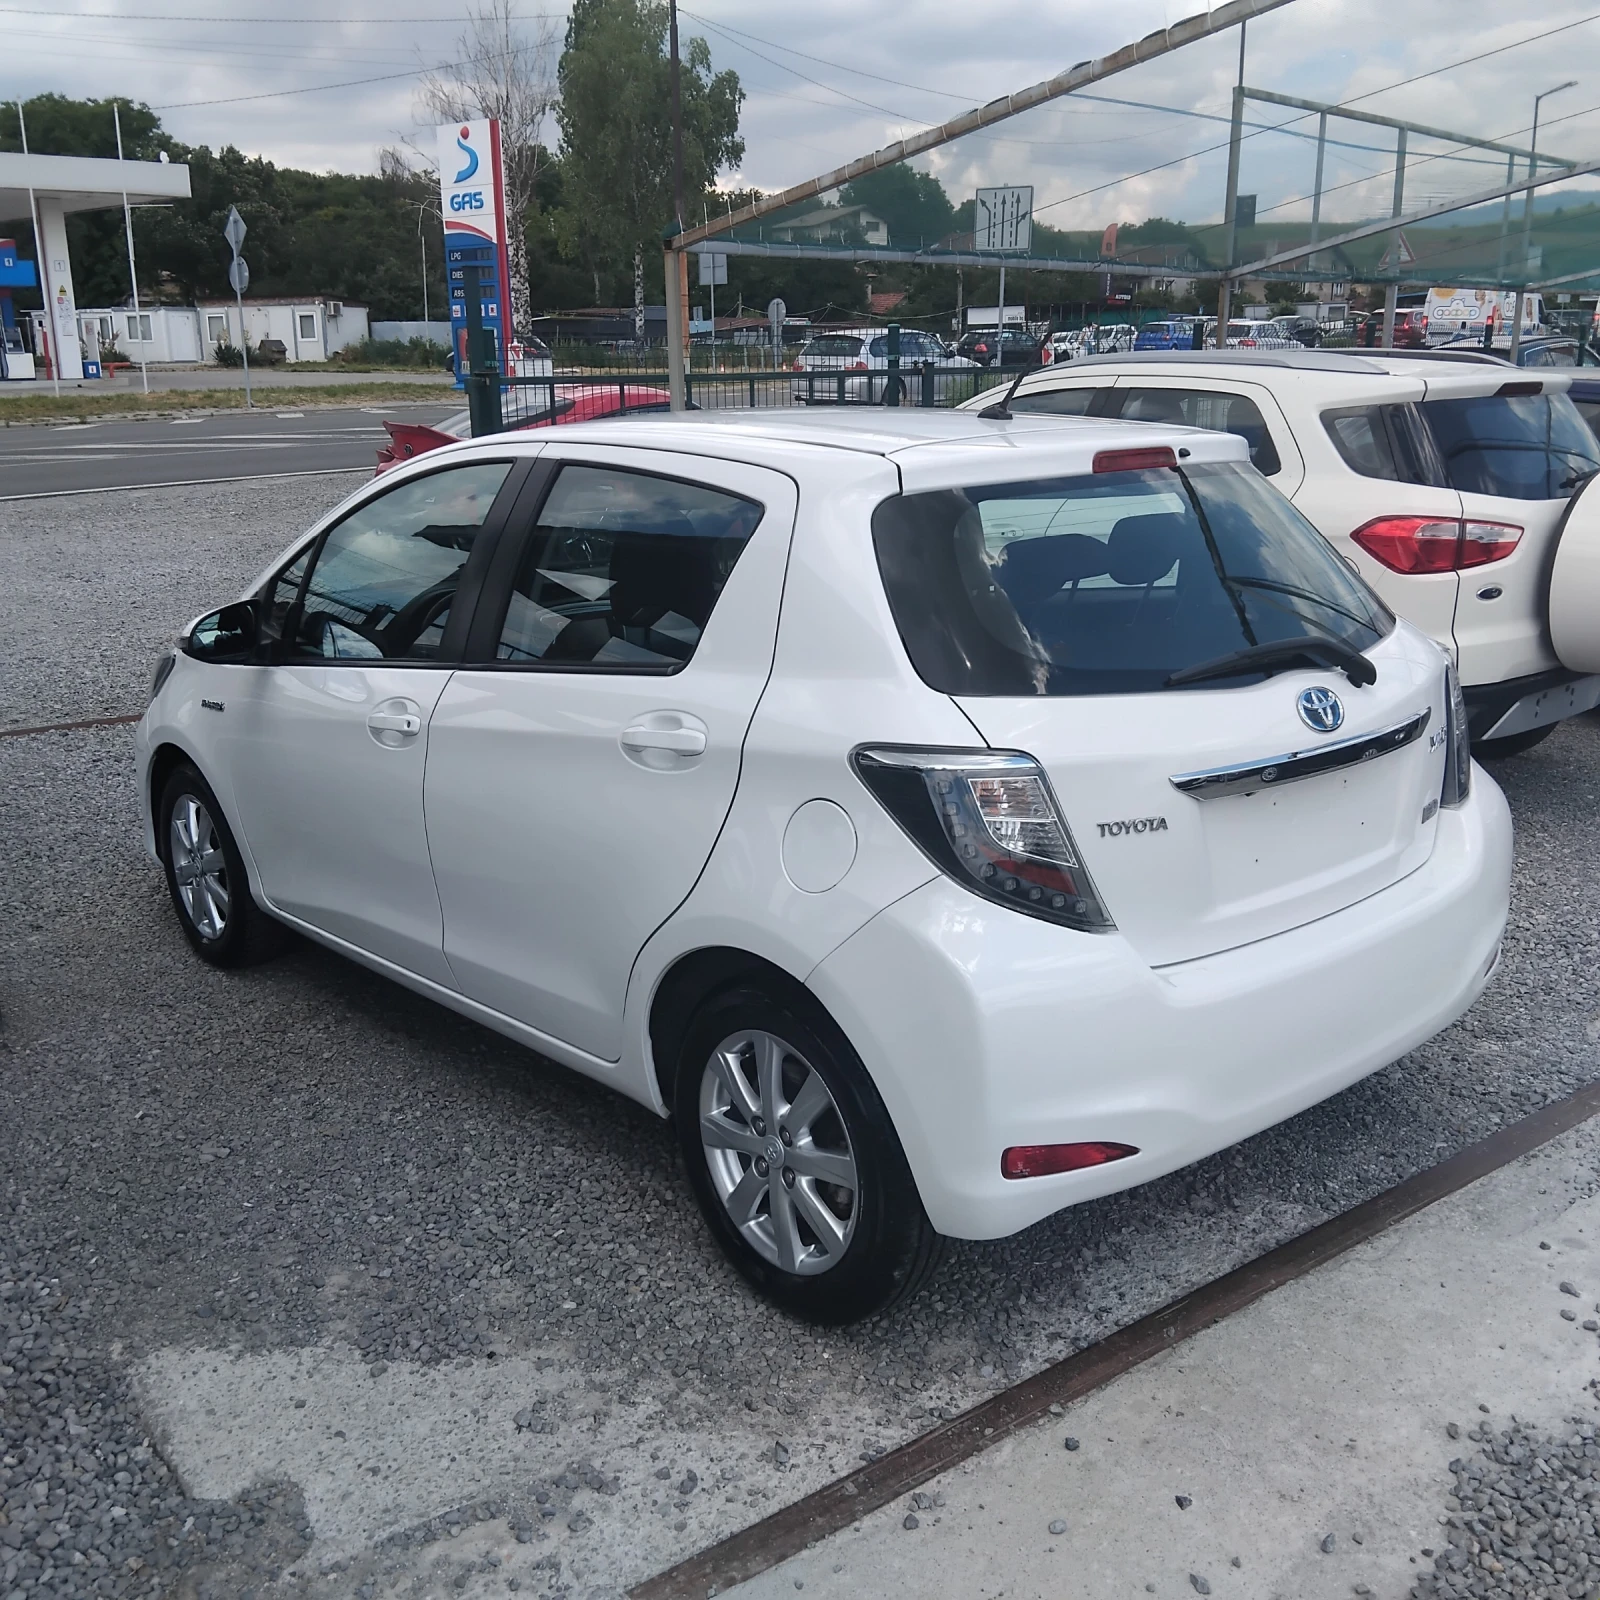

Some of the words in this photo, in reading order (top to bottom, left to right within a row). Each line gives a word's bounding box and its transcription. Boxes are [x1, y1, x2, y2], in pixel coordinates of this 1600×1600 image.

[450, 191, 484, 211] GAS
[450, 252, 462, 261] LPG
[1096, 816, 1168, 838] TOYOTA
